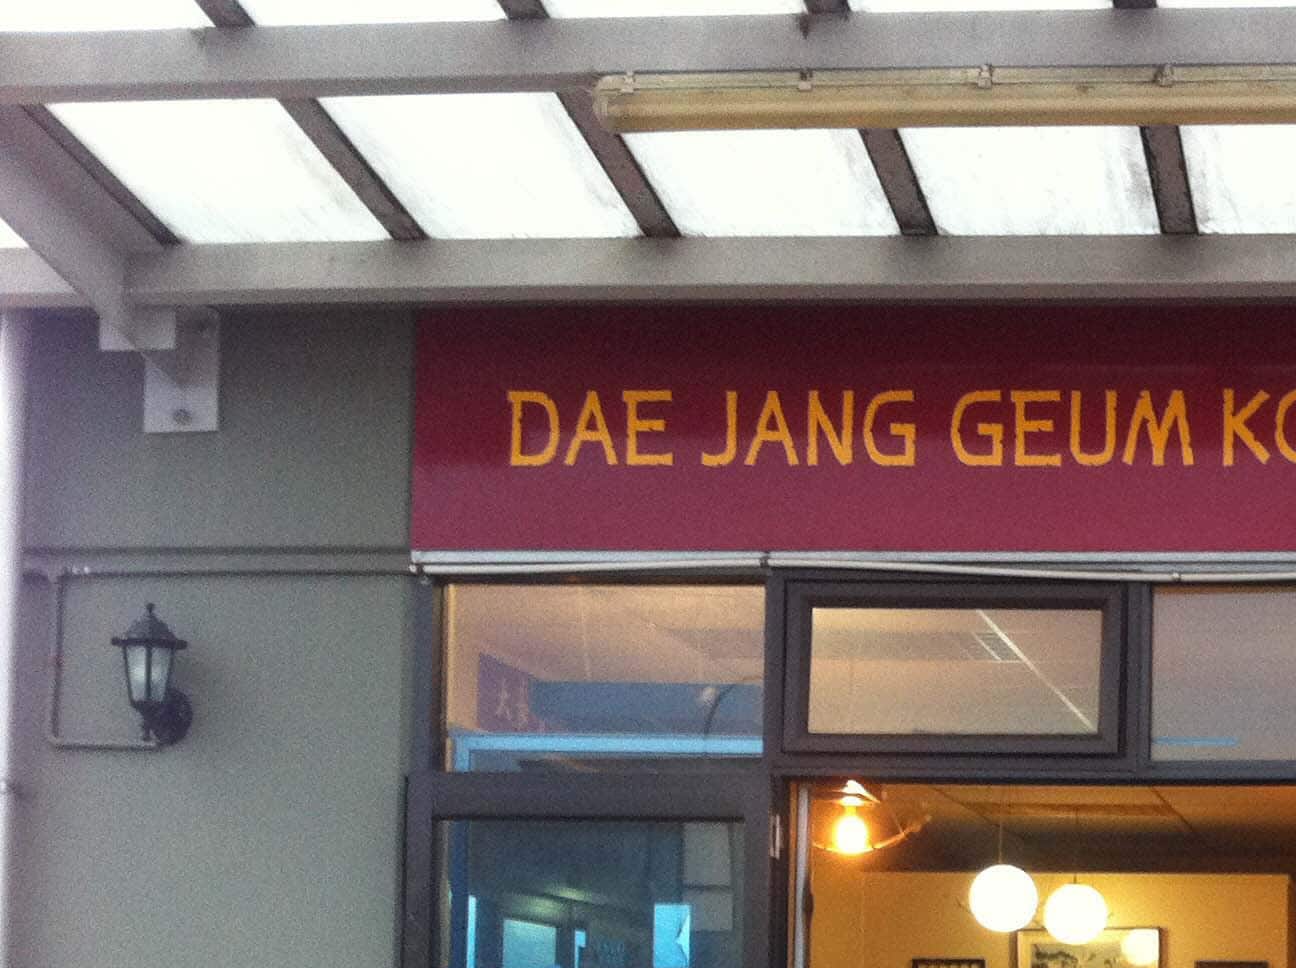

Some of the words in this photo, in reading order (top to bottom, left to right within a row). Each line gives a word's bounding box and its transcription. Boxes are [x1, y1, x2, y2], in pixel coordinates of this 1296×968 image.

[507, 389, 674, 468] DAE
[701, 389, 917, 468] JANG
[949, 388, 1196, 468] GEUM
